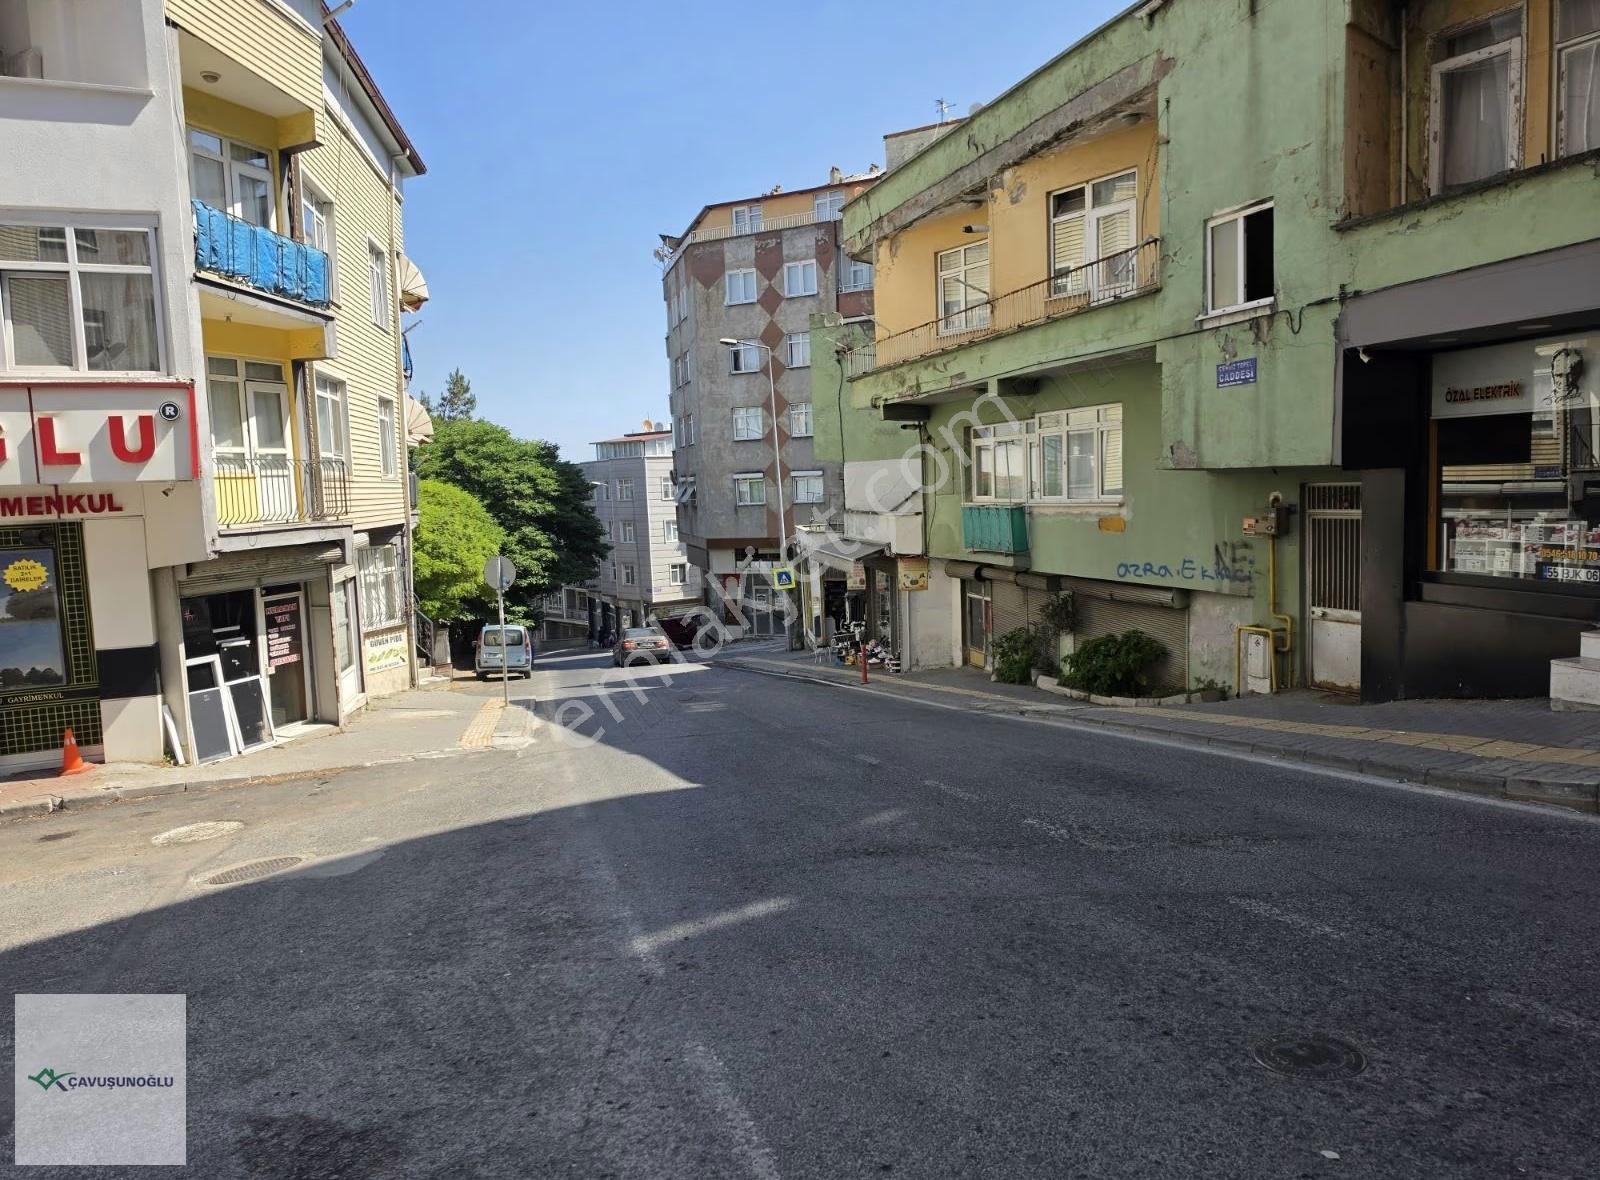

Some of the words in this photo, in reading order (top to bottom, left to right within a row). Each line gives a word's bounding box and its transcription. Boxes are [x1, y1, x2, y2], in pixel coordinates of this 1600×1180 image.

[1445, 387, 1472, 403] ÖZAL
[1473, 380, 1521, 400] ELEKTRİK
[0, 415, 156, 465] LU
[1547, 567, 1559, 578] 55
[1562, 568, 1582, 579] BJK
[1586, 570, 1598, 581] 06
[7, 692, 65, 704] GAYRİMENKUL
